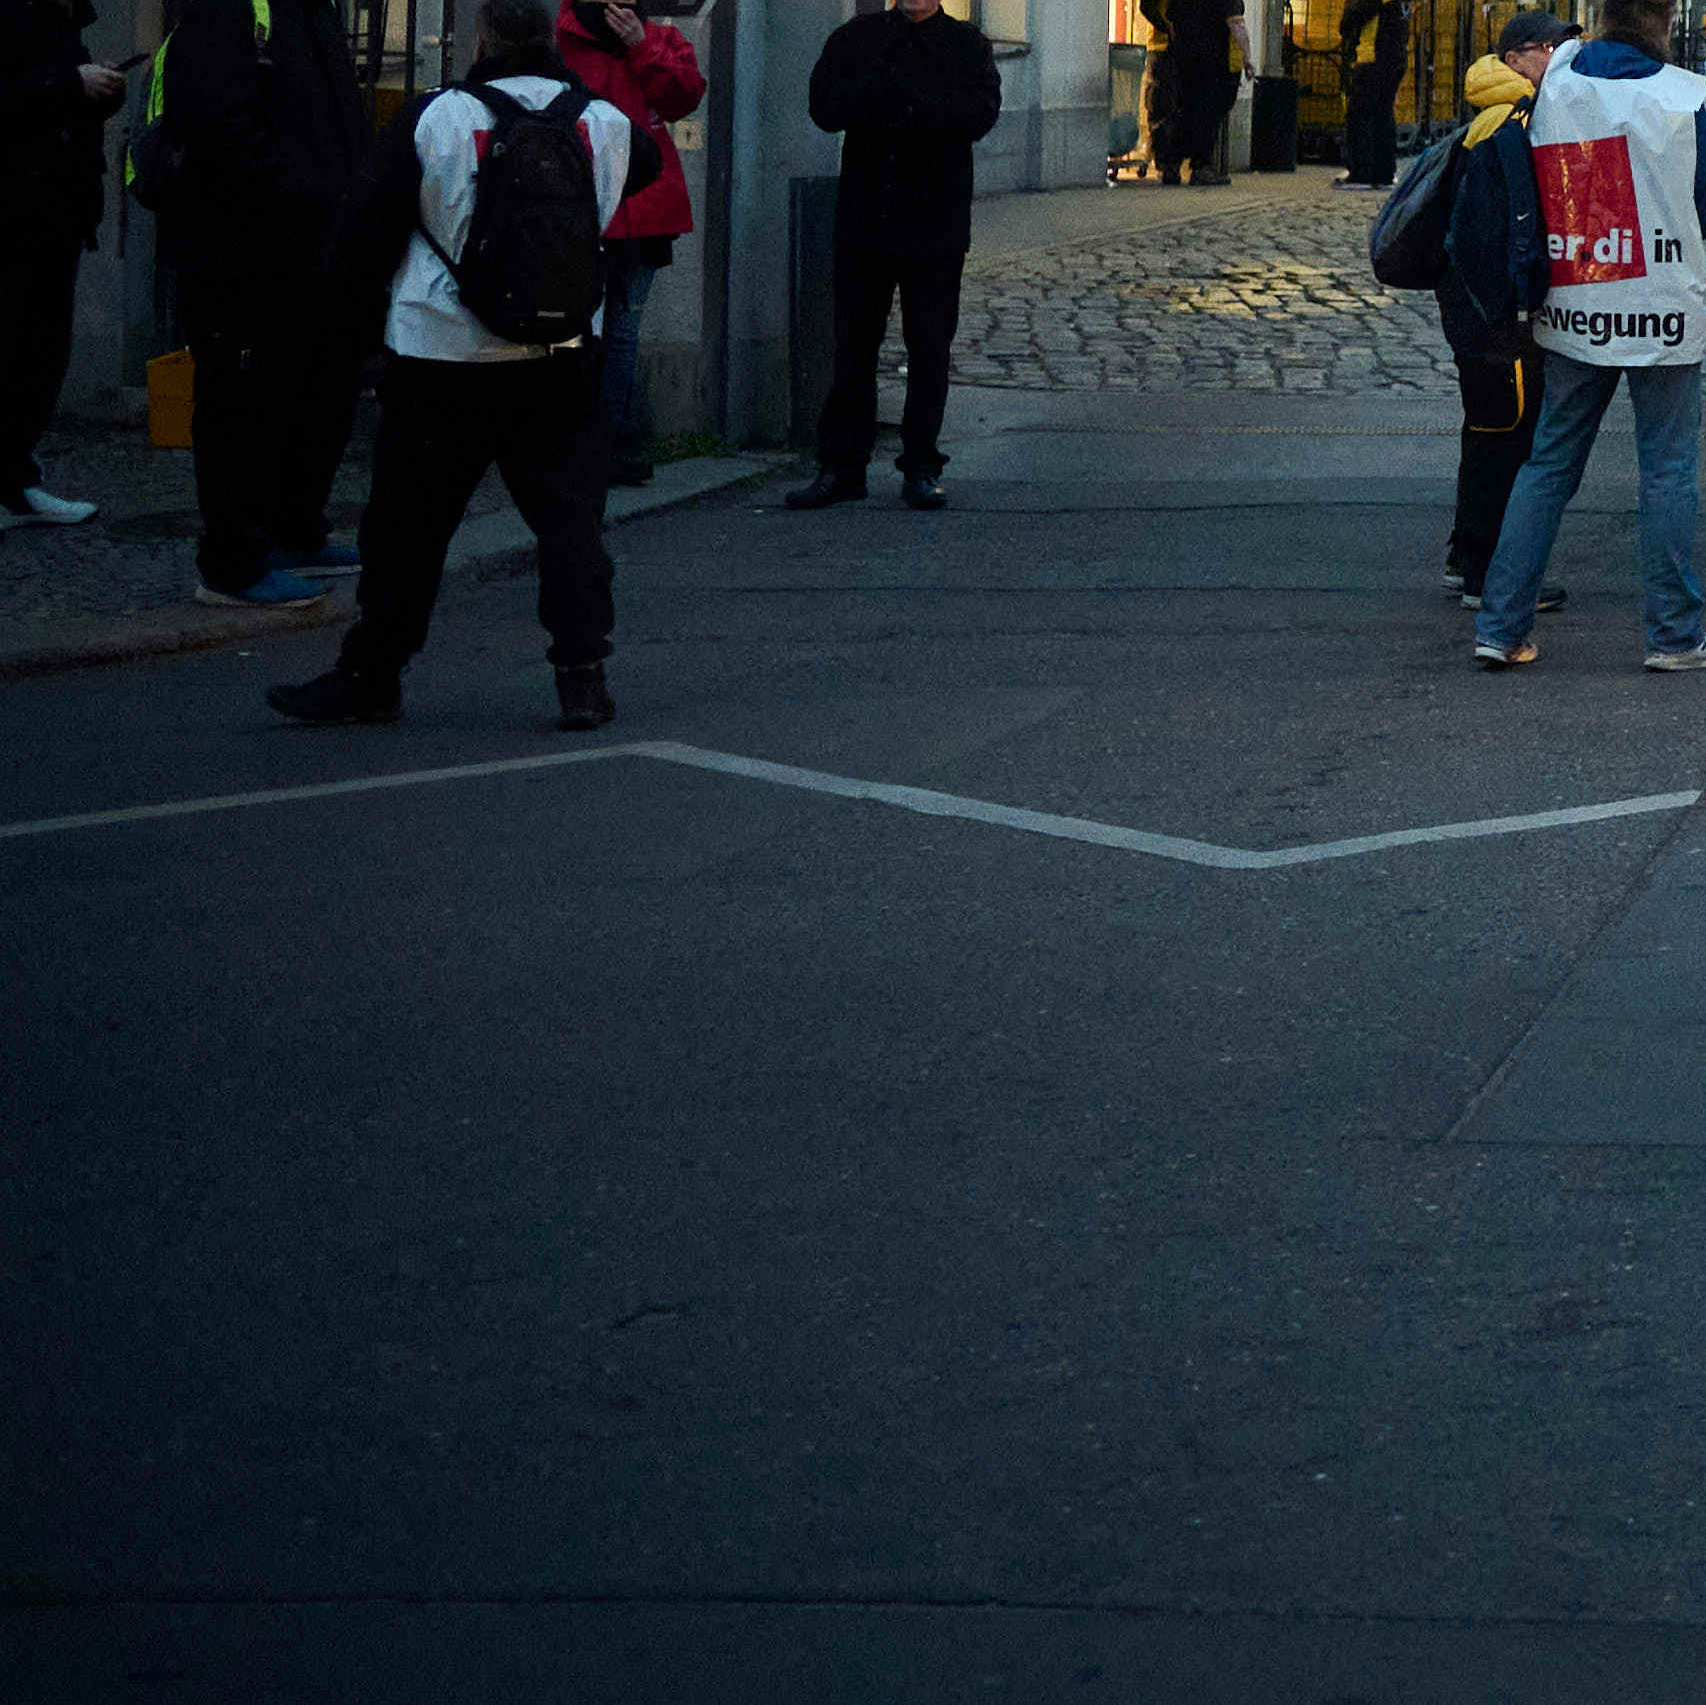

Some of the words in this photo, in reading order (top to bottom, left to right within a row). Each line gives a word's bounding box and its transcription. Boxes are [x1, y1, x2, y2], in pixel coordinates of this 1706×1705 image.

[1547, 228, 1633, 264] er.di
[1654, 228, 1682, 263] in
[1537, 304, 1685, 346] wegung
